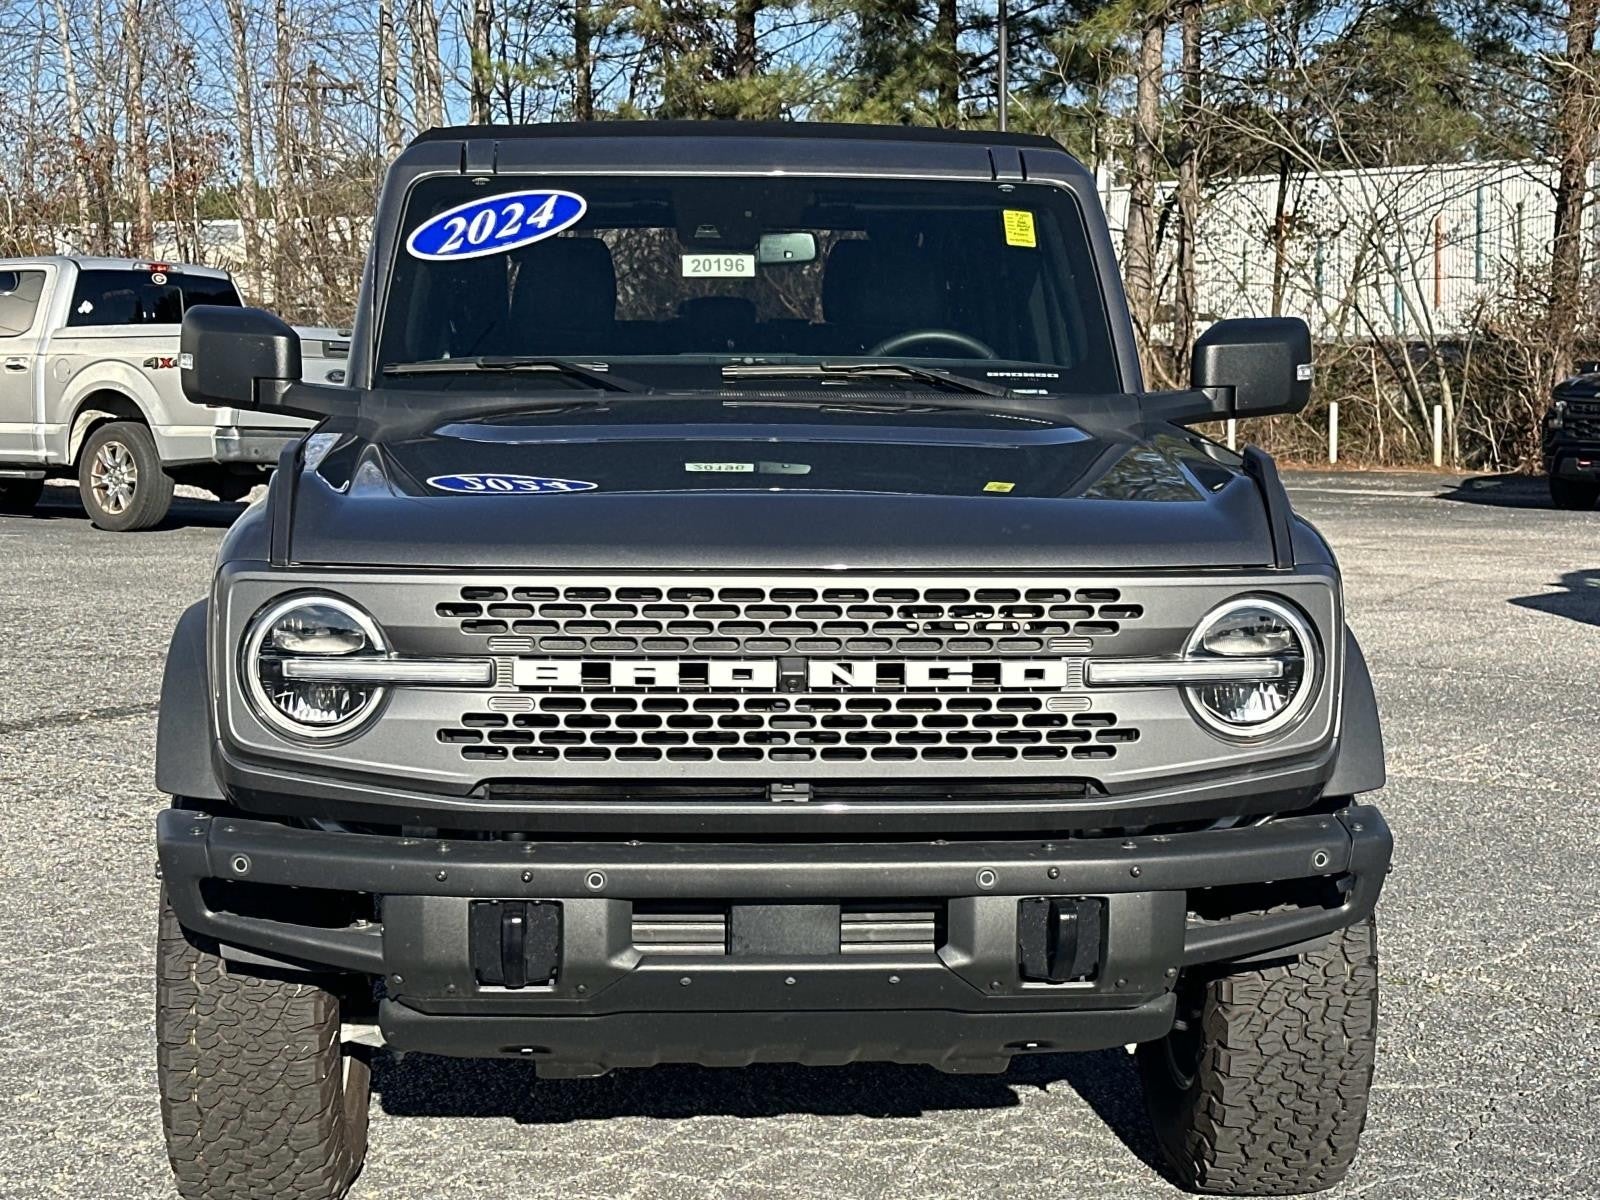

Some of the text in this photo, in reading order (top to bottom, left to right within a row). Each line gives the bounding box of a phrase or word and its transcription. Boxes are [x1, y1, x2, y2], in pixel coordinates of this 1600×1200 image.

[436, 194, 559, 254] 2024
[691, 258, 745, 273] 20196
[512, 659, 1067, 689] BRONCO
